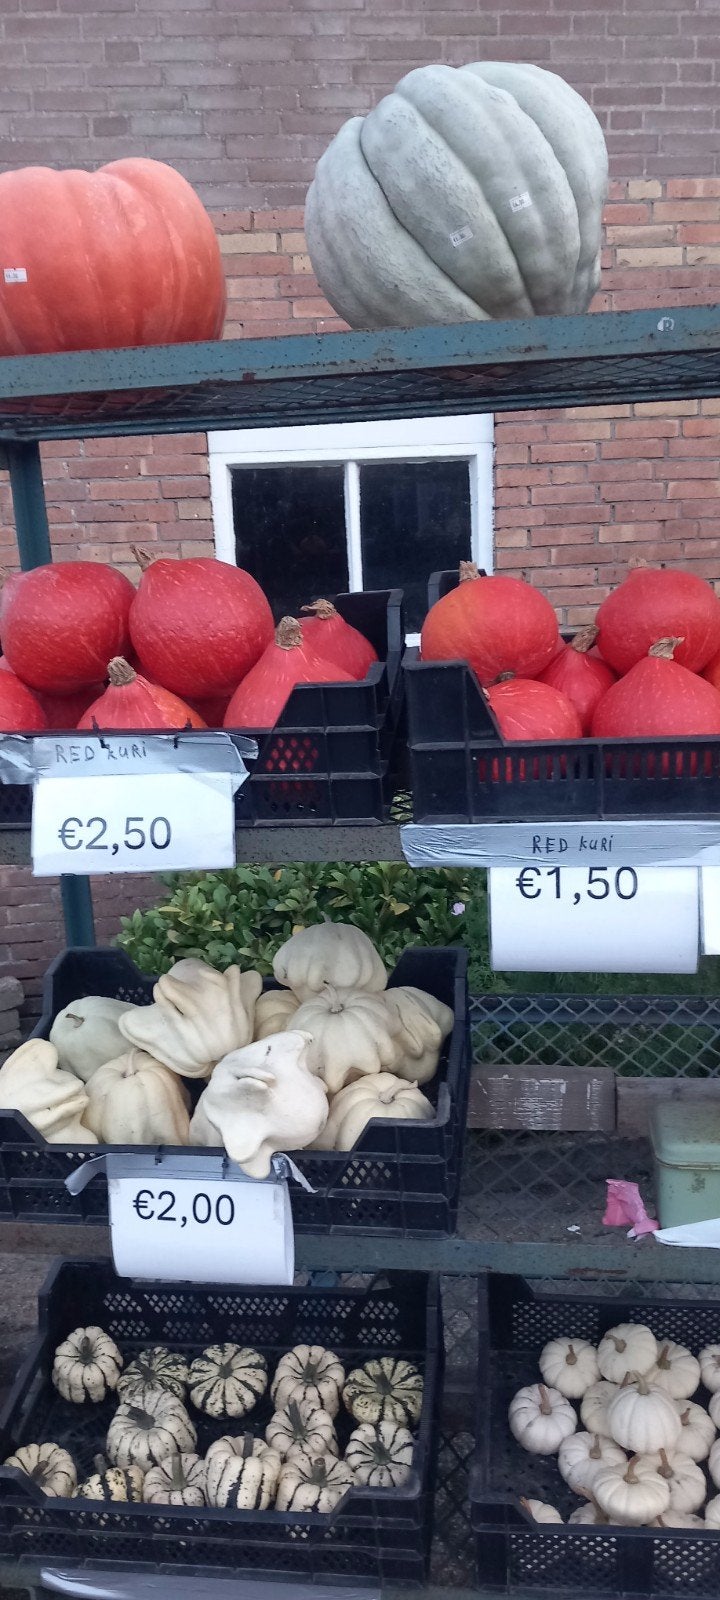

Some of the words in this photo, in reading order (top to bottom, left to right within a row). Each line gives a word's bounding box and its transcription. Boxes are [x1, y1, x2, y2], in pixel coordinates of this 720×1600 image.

[55, 744, 95, 763] RED
[58, 816, 172, 855] €2,50
[532, 835, 568, 853] RED
[515, 866, 638, 905] €1,50
[132, 1189, 235, 1228] €2,00
